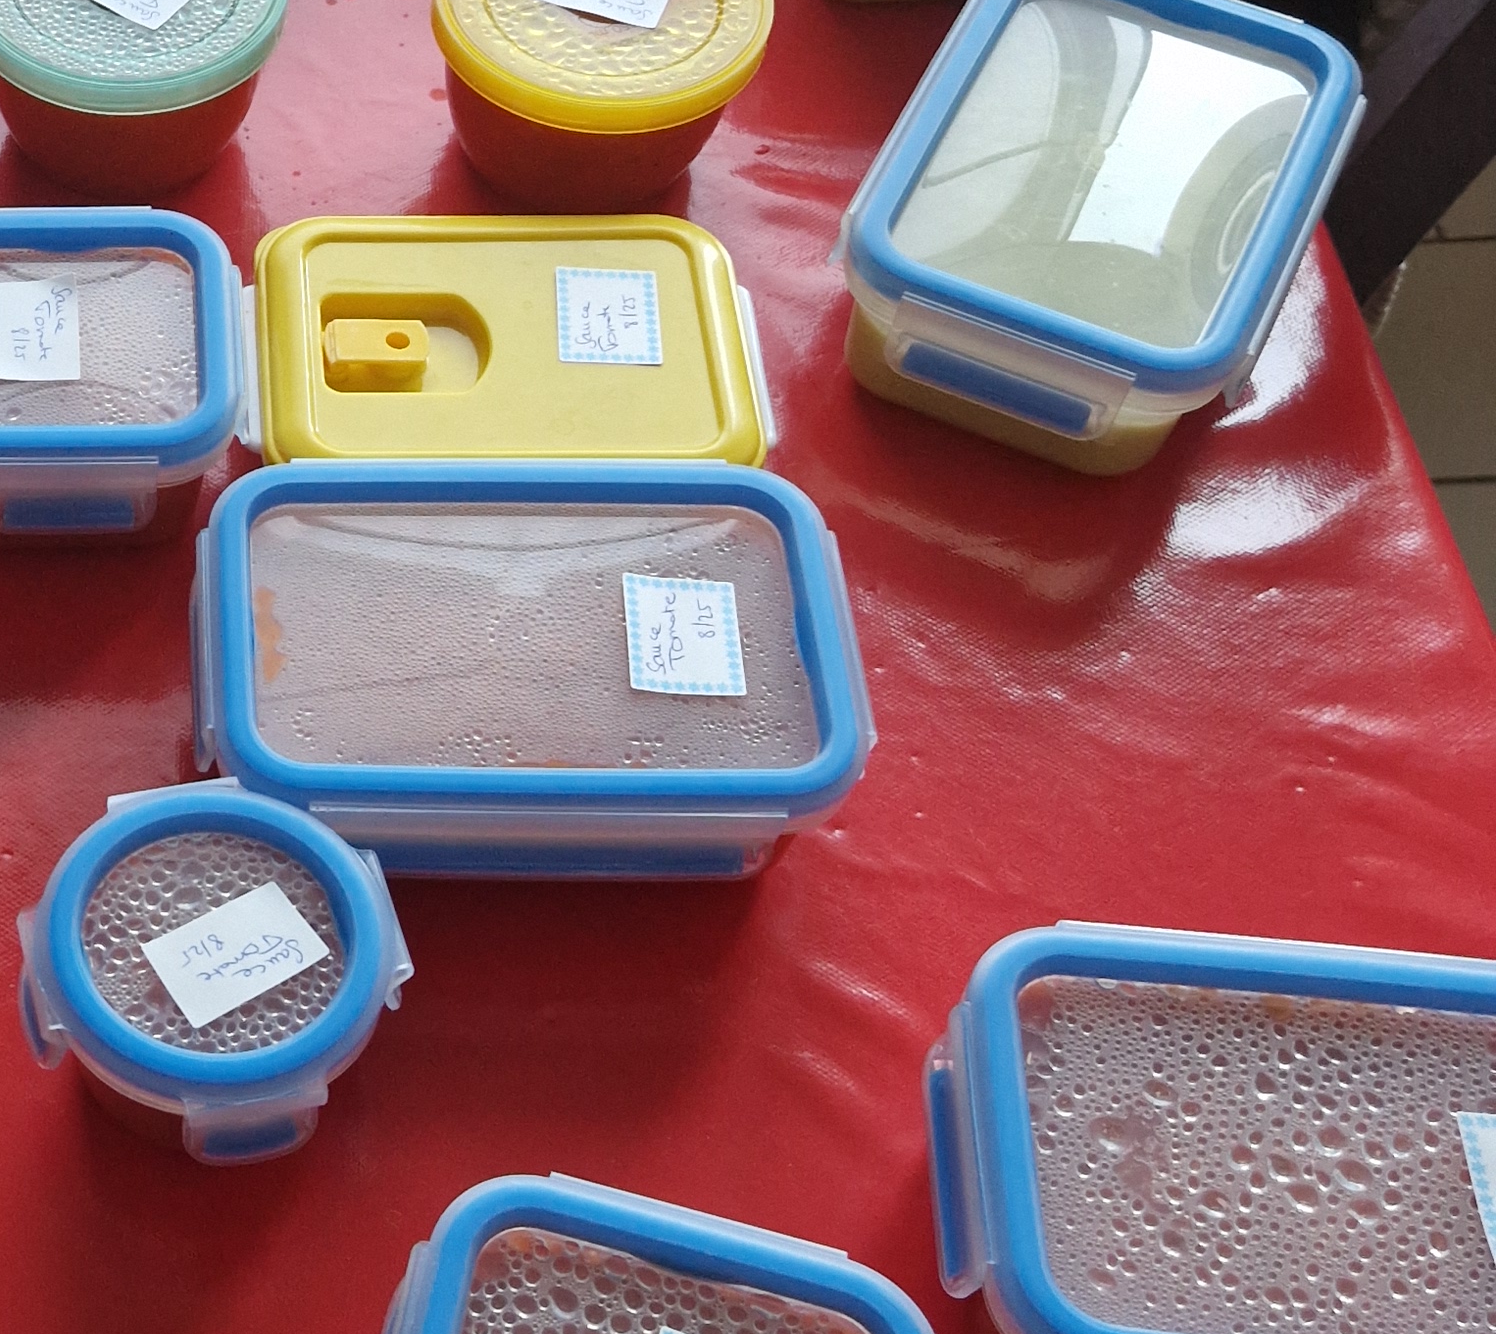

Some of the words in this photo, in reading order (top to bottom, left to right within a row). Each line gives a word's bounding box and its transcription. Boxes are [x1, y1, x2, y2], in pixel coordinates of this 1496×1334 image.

[599, 0, 653, 20] Sauce
[34, 299, 53, 361] Tomate
[51, 287, 73, 335] Sauce
[574, 301, 597, 349] Sauce
[618, 294, 639, 329] 8/25
[10, 327, 31, 361] 8/25
[662, 592, 686, 671] Tomate
[690, 598, 716, 639] 8/25
[645, 623, 667, 675] Sauce
[182, 933, 224, 968] 8/25
[196, 934, 283, 981] Tomate
[232, 938, 304, 978] Sauce
